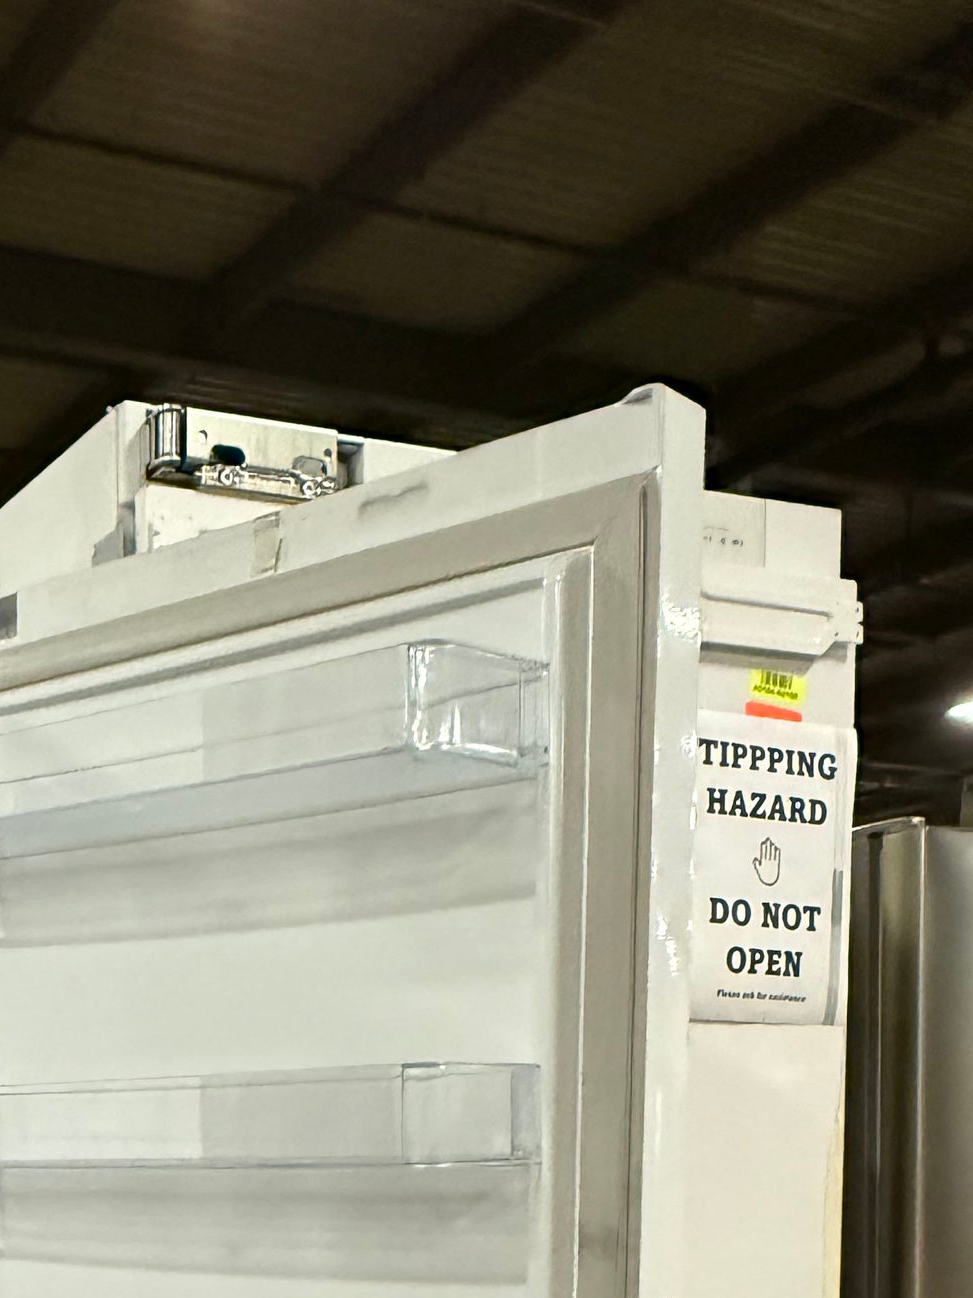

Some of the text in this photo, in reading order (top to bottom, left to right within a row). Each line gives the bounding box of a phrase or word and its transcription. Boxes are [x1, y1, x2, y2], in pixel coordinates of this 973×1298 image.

[698, 738, 838, 781] TIPPPING
[706, 787, 828, 825] HAZARD
[709, 897, 822, 932] DO NOT
[726, 946, 803, 978] OPEN
